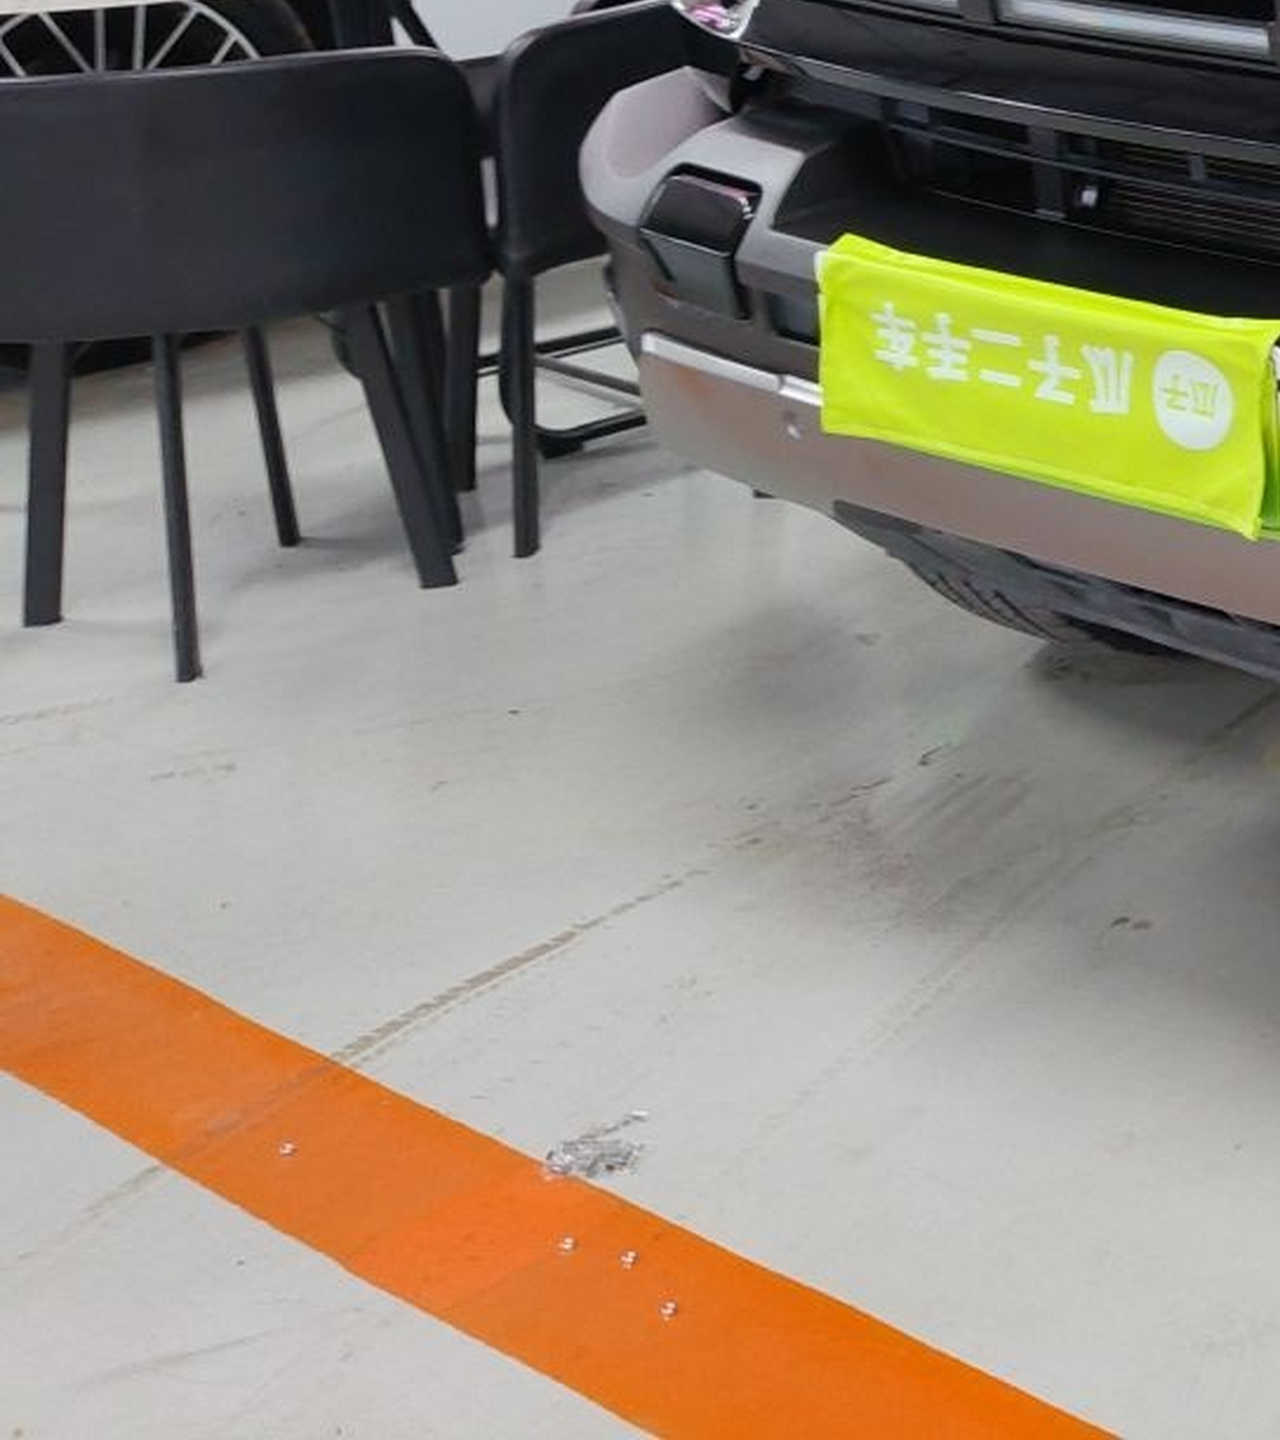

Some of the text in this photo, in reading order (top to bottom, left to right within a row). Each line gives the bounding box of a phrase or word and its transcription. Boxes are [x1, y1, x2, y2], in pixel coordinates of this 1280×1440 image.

[870, 300, 1134, 415] 瓜子二手车
